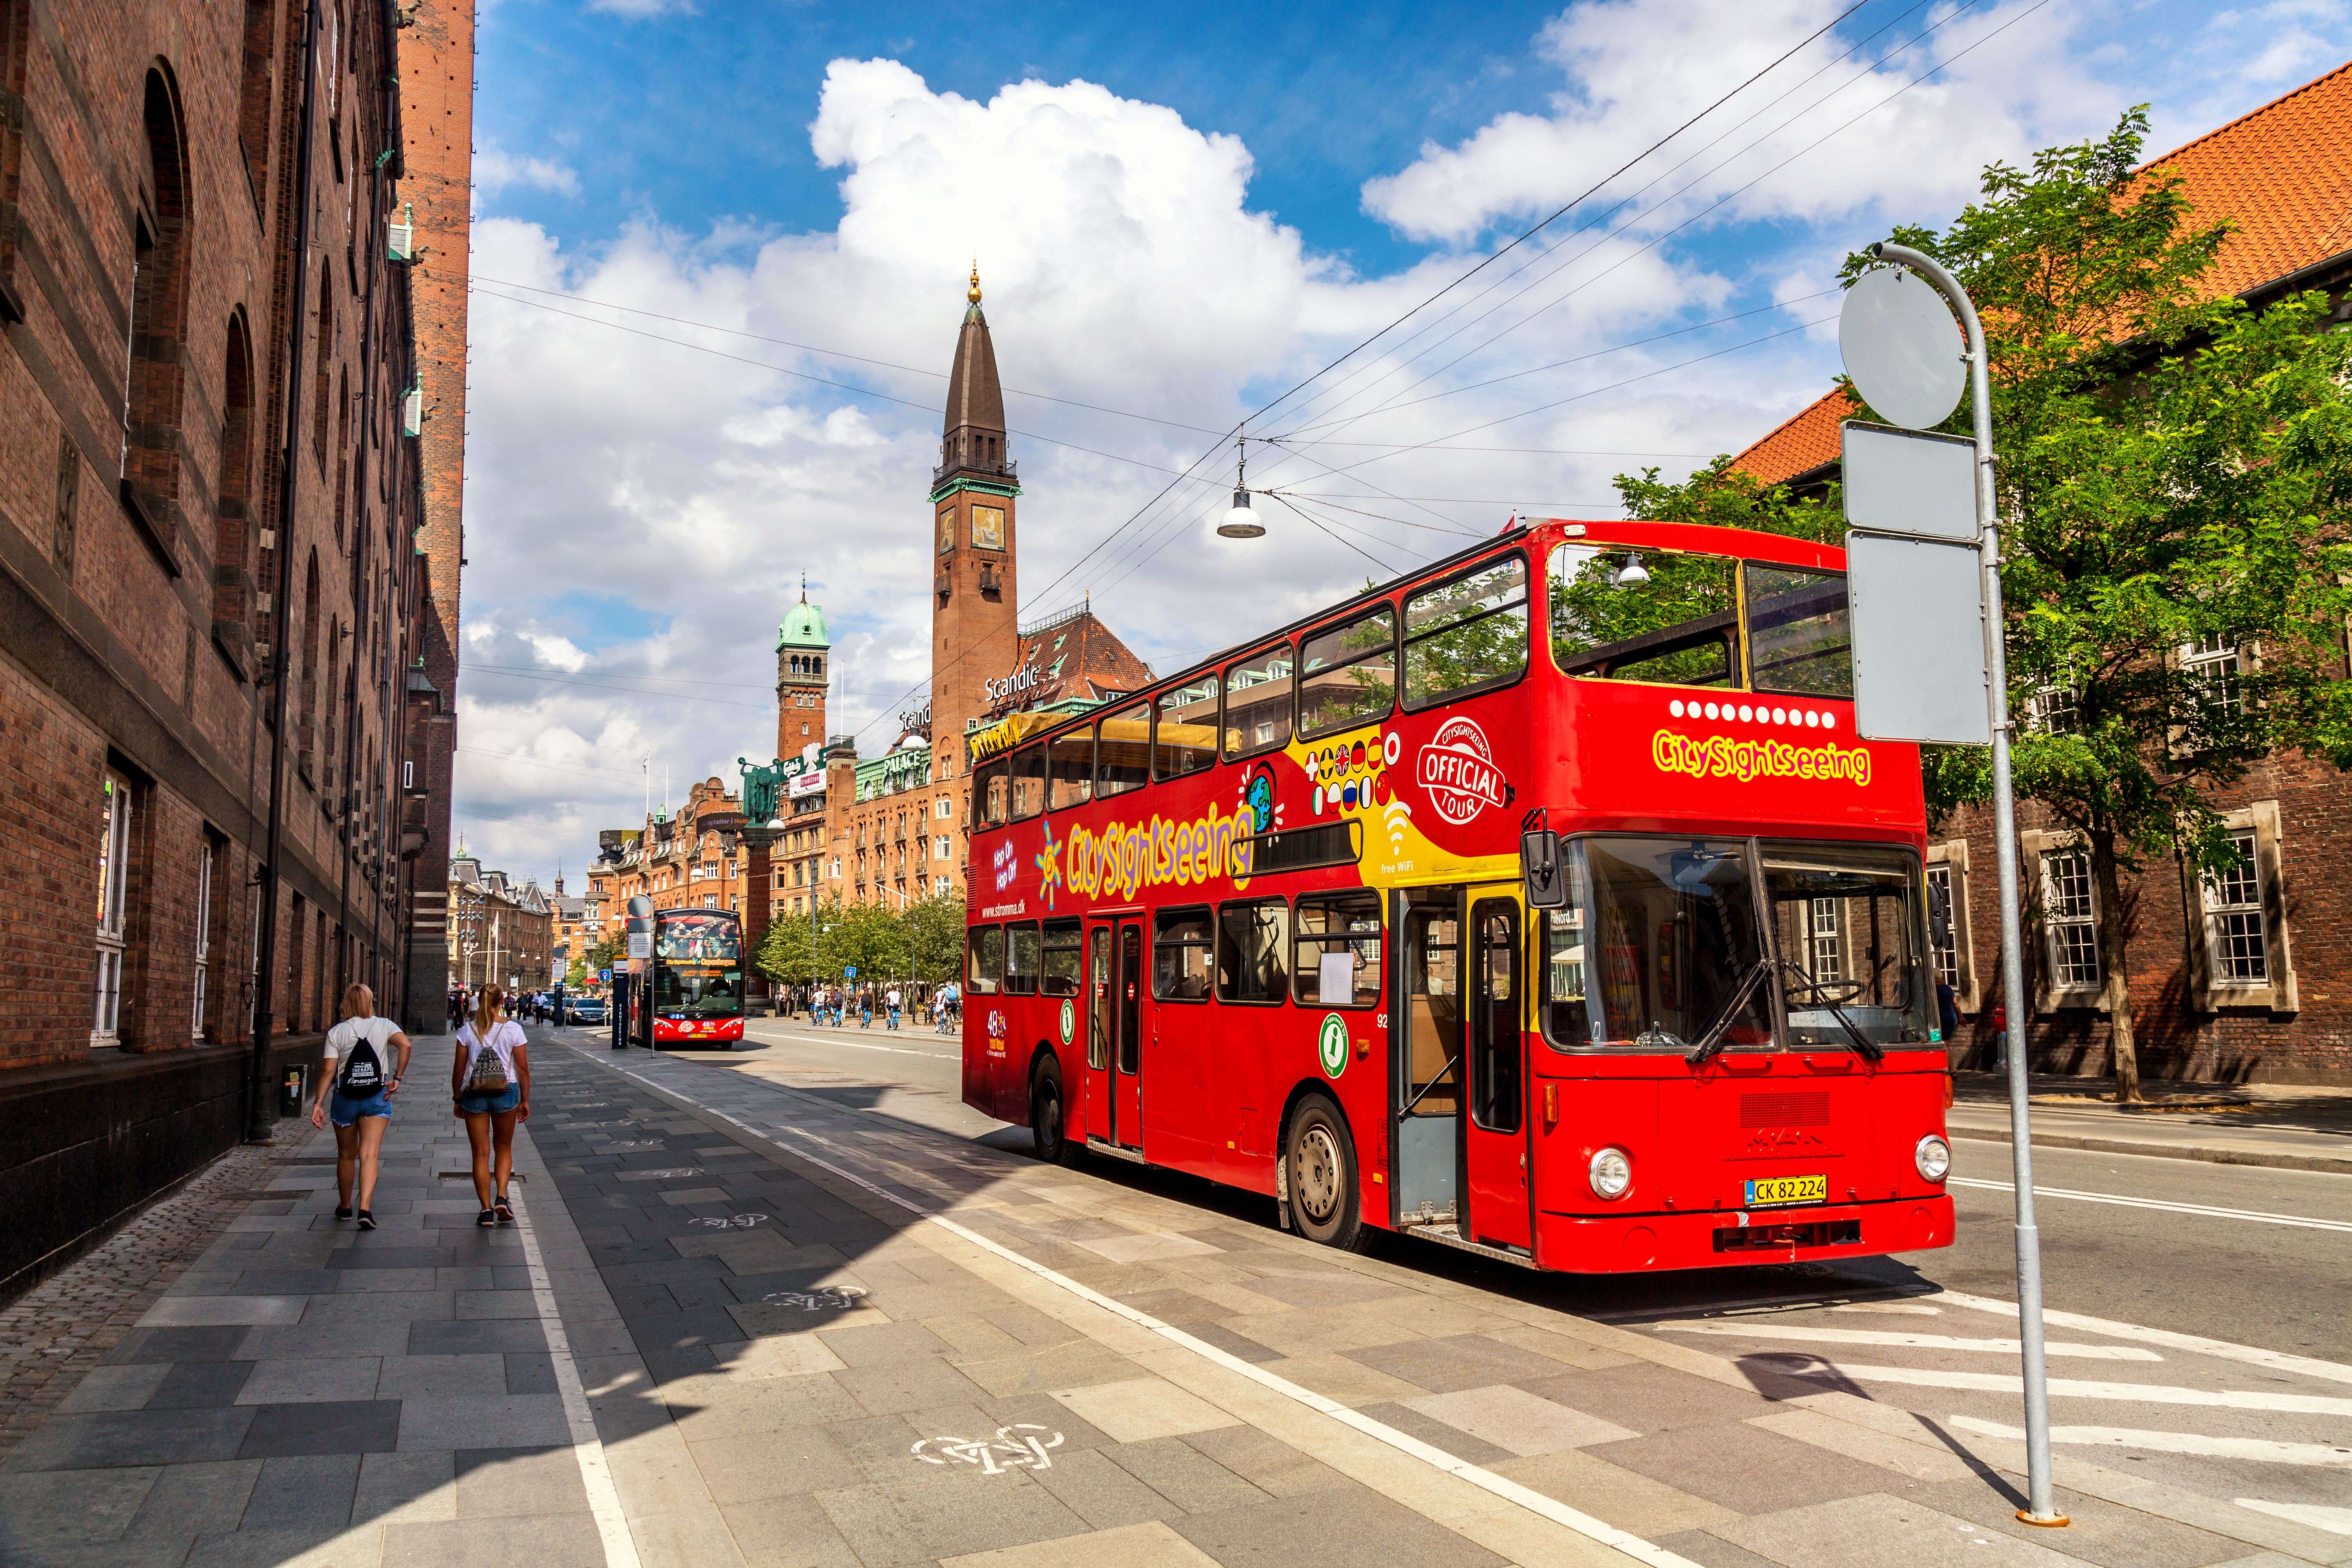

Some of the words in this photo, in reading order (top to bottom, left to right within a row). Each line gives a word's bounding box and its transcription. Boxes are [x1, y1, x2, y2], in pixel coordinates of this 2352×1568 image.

[985, 663, 1038, 702] Scandic
[1442, 724, 1487, 757] CITYSIGHTSEEING
[884, 750, 920, 775] PALACE
[1652, 729, 1871, 786] CitySightseeing
[801, 776, 820, 784] Kreditten
[1426, 753, 1499, 801] OFFICIAL
[1441, 790, 1476, 817] TOUR
[994, 849, 1004, 869] Hop
[1005, 840, 1013, 861] On
[1067, 802, 1254, 902] CitySightseeing
[997, 871, 1007, 891] Hop
[1008, 858, 1017, 884] Off
[1381, 863, 1396, 874] free
[1397, 860, 1413, 872] WiFi
[982, 899, 1025, 918] www.stromma.dk
[1556, 910, 1570, 925] Nord
[700, 958, 736, 967] Copenhagen
[987, 1010, 997, 1037] 48
[1327, 1017, 1343, 1029] Approved
[1341, 1027, 1346, 1037] by
[1377, 1013, 1388, 1028] 92
[1756, 1183, 1775, 1200] CK
[1778, 1182, 1795, 1198] 82
[1799, 1179, 1824, 1197] 224
